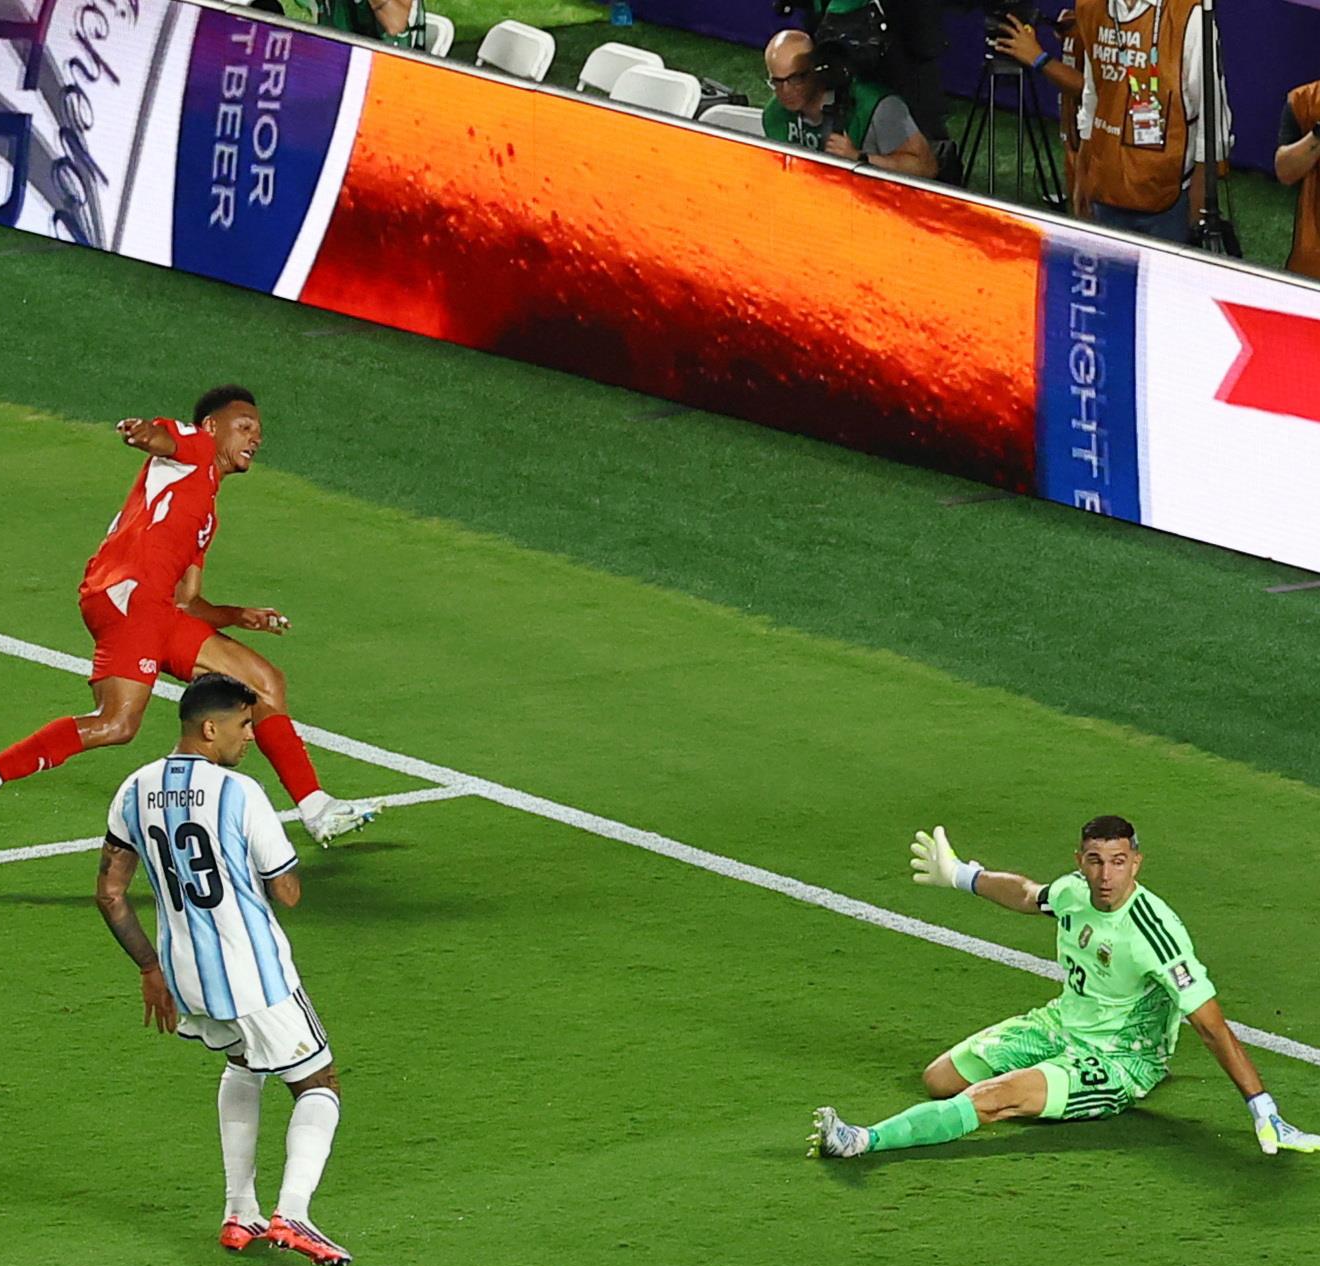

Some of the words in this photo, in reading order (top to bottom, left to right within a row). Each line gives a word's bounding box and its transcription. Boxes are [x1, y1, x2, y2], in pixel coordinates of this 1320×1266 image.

[1092, 43, 1148, 69] PARTER
[208, 64, 249, 230] BEER
[248, 31, 293, 206] ERIOR
[147, 789, 205, 810] ROMERO
[148, 822, 225, 912] 13
